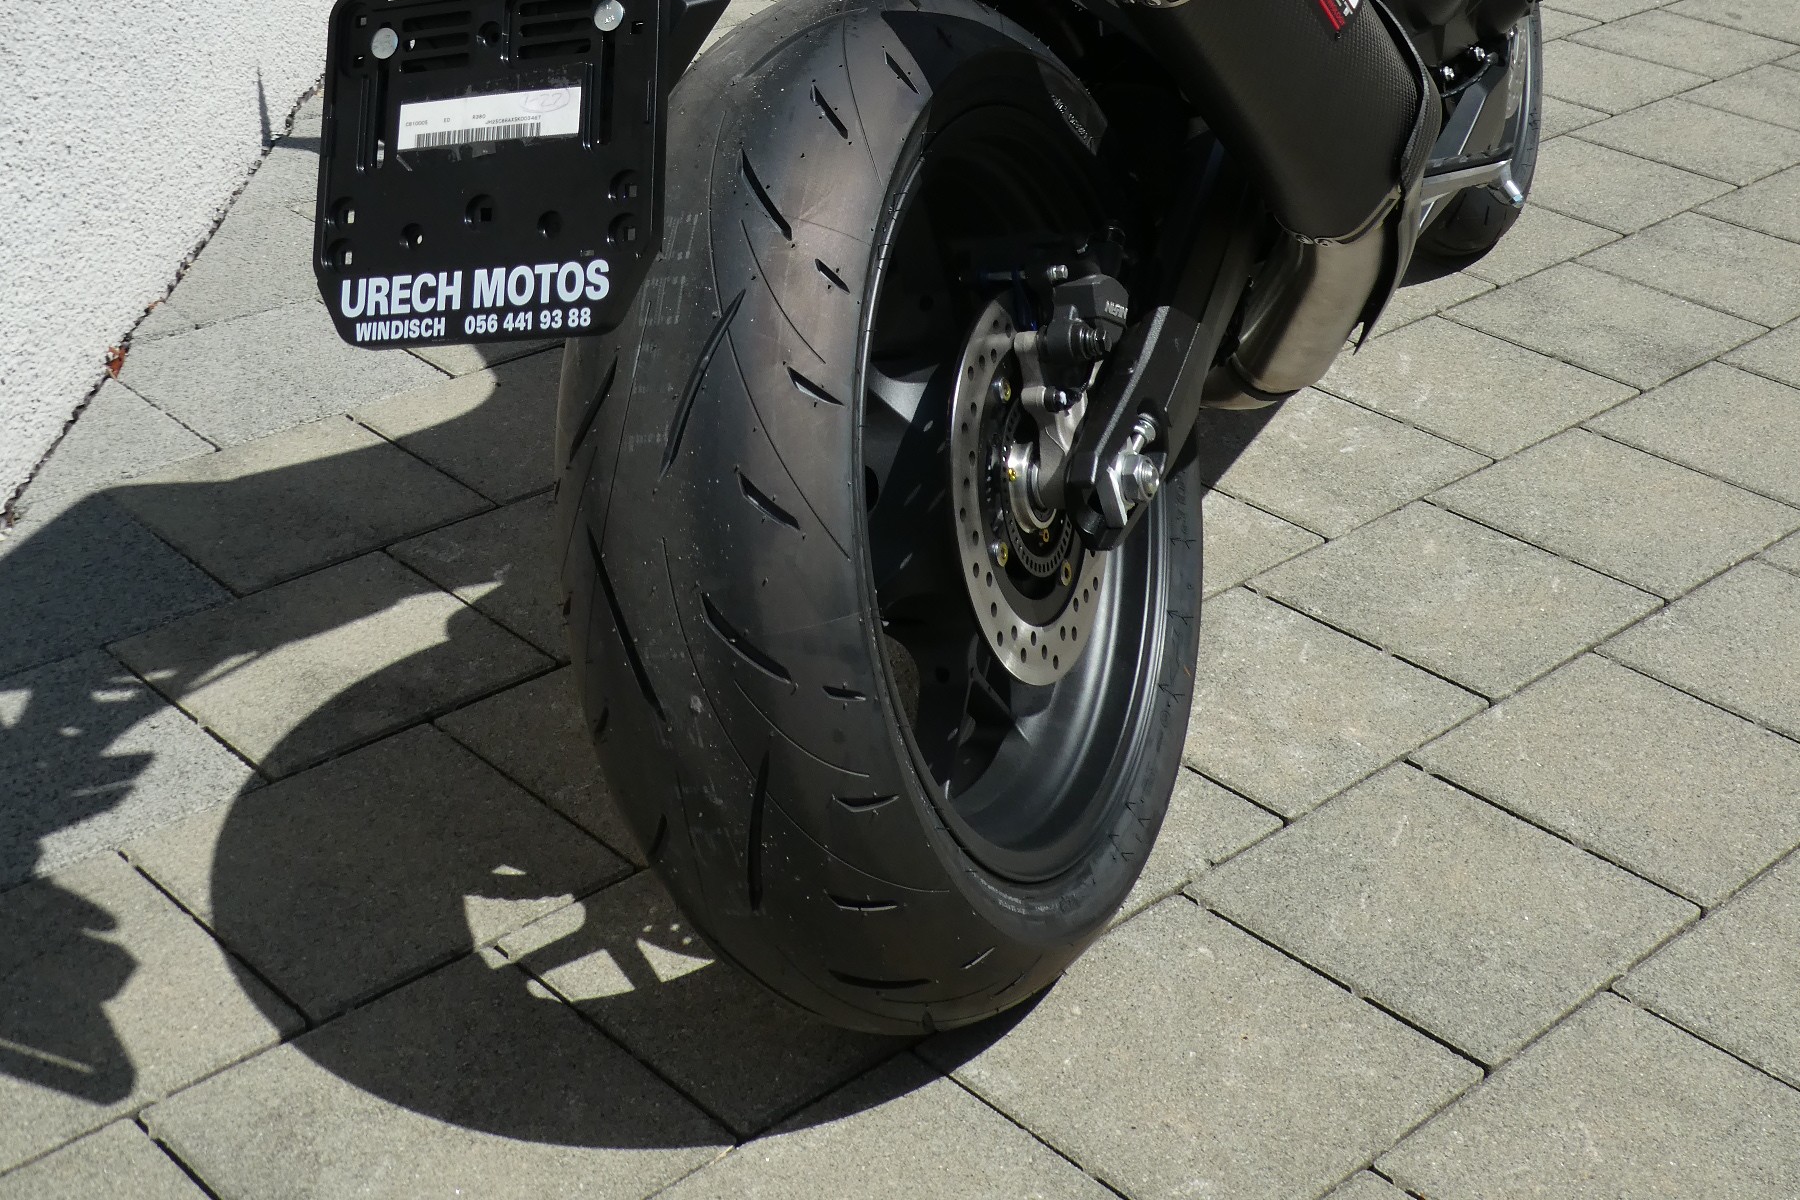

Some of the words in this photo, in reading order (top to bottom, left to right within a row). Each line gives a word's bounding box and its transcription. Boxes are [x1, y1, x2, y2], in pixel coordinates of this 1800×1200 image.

[341, 270, 463, 318] URECH
[472, 259, 609, 308] MOTOS
[356, 316, 446, 341] WINDISCH
[464, 313, 498, 335] 056
[503, 311, 533, 332] 441
[540, 308, 562, 330] 93
[567, 307, 591, 328] 88
